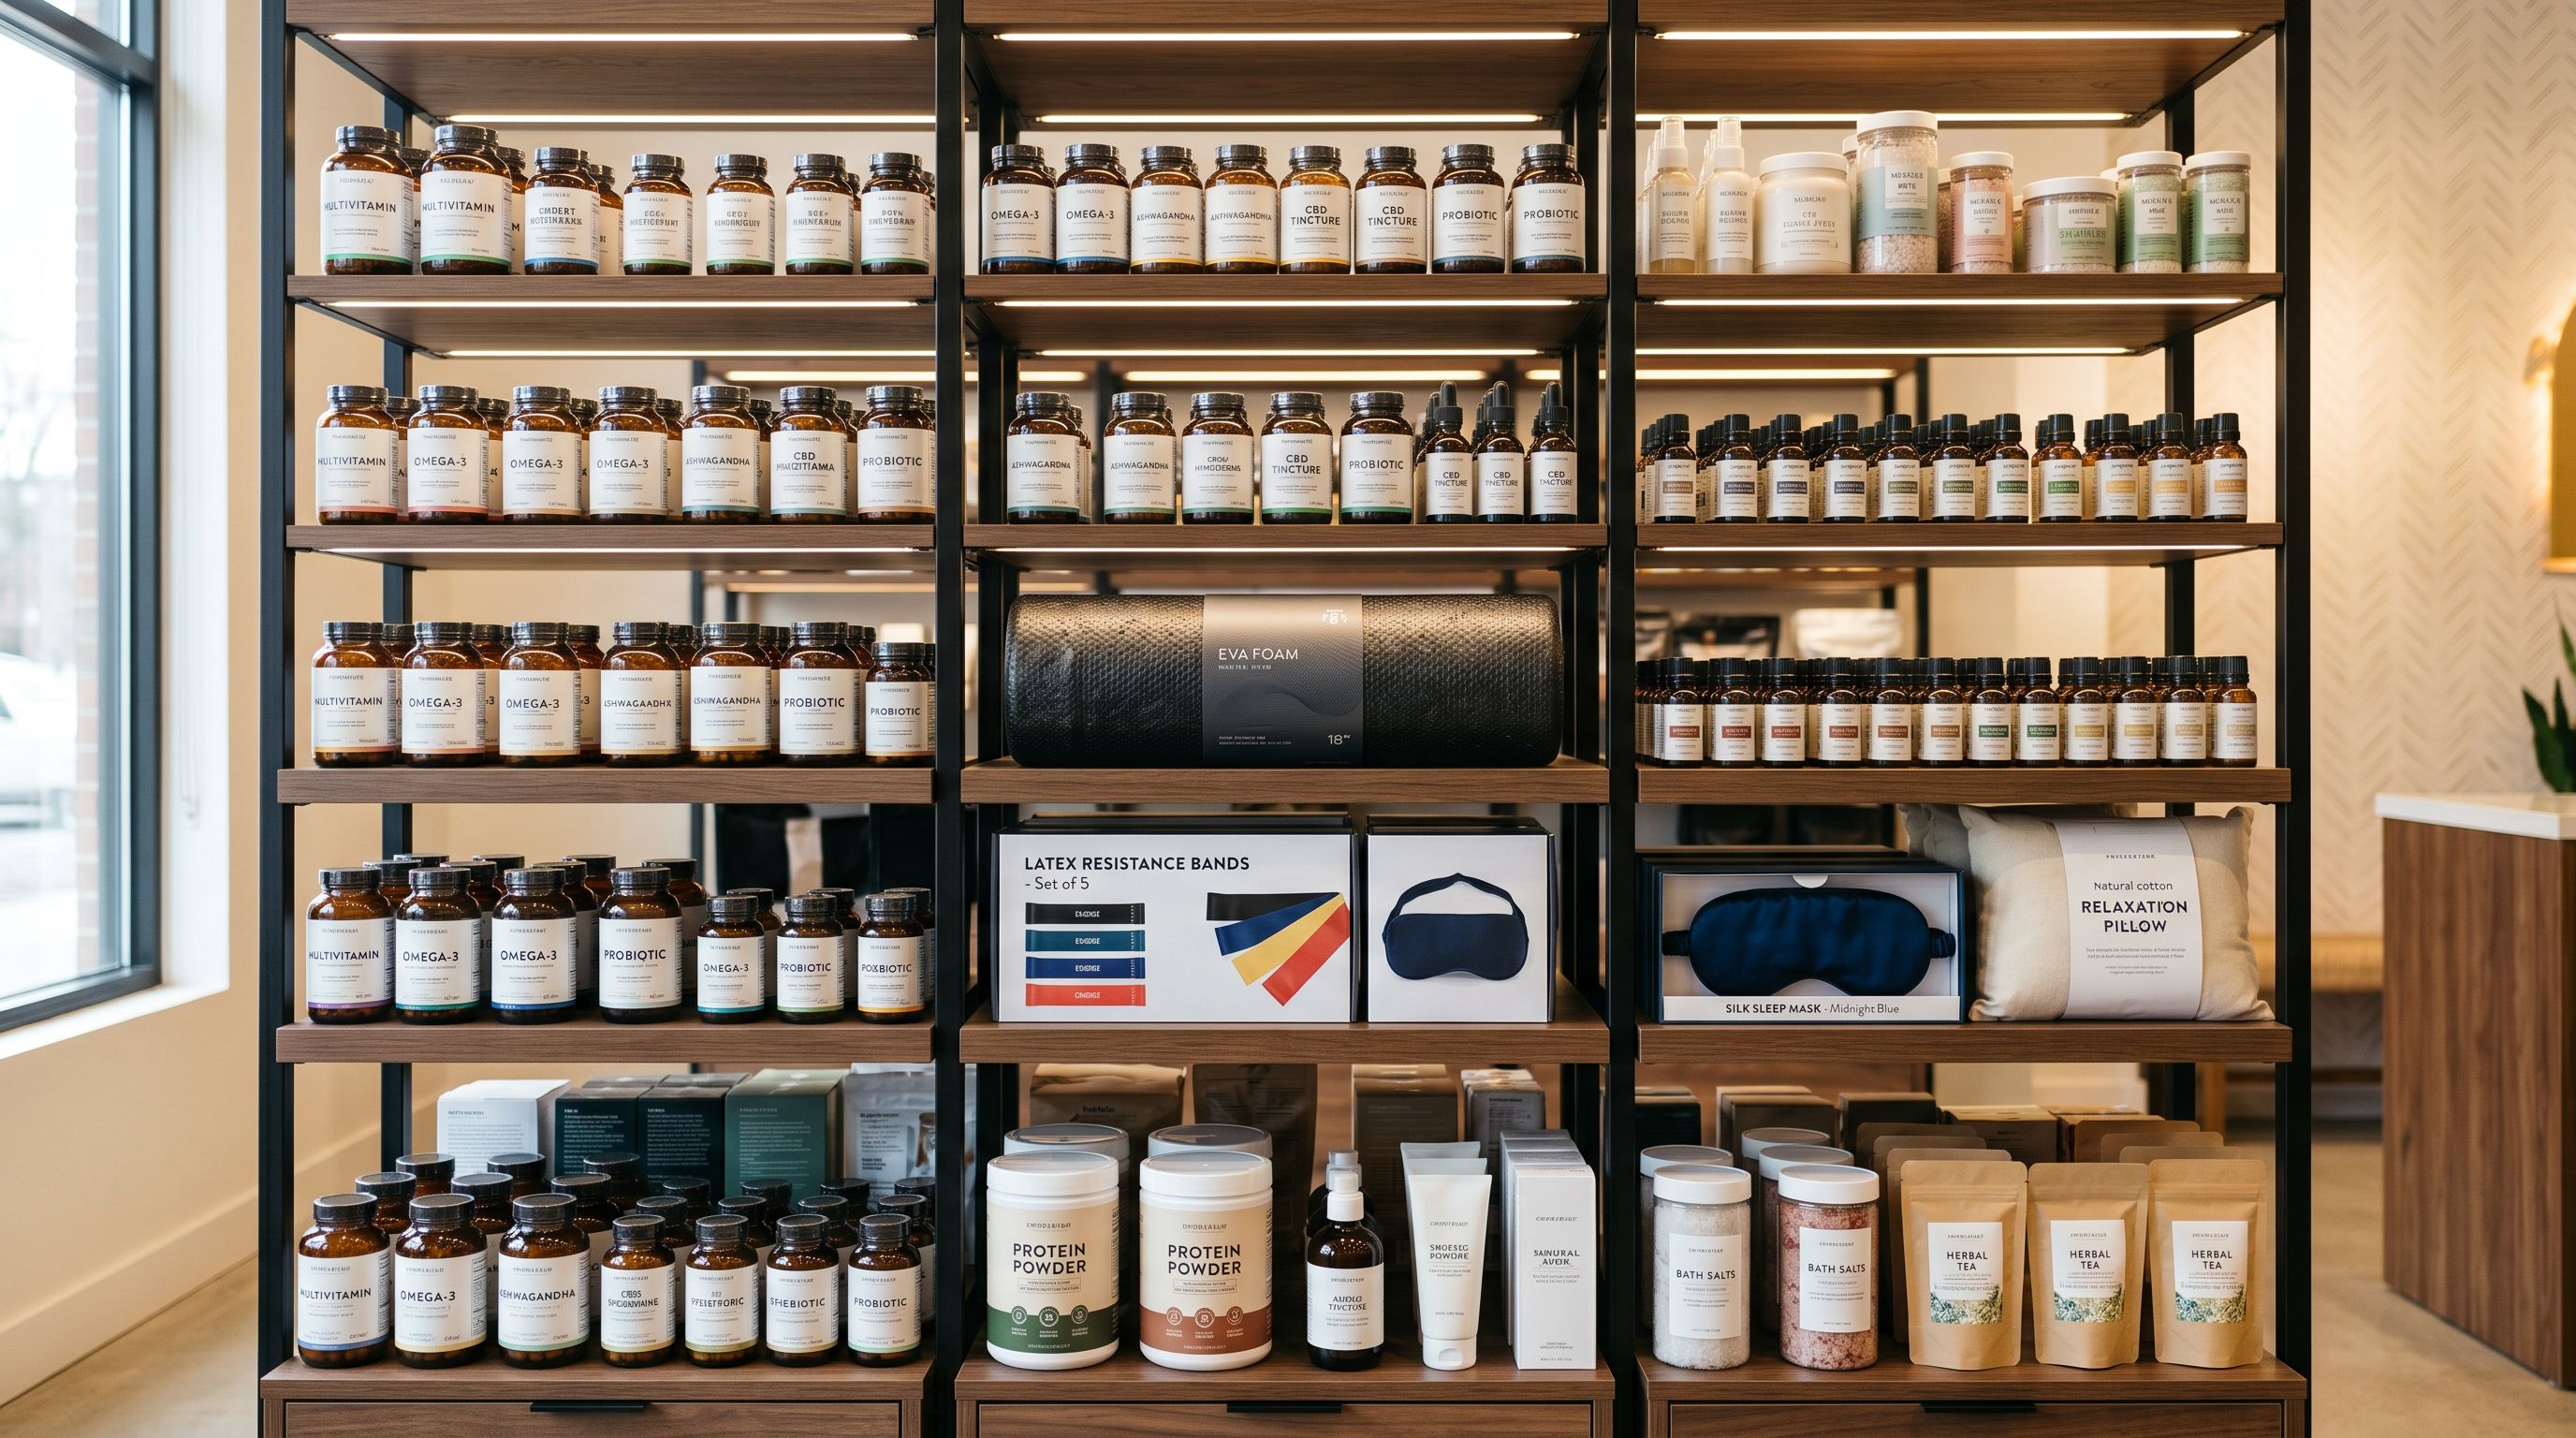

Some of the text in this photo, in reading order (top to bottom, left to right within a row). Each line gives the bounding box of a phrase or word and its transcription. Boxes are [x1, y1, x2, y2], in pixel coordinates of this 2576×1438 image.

[991, 211, 1039, 219] OMEGA-3
[1067, 210, 1114, 219] OMEGA-3
[1137, 213, 1194, 221] ASHWAGANDHA
[1443, 211, 1497, 220] PROBIOTIC
[1525, 210, 1578, 219] PROBIOTIC
[1292, 216, 1339, 225] TINCTURE
[1368, 217, 1417, 226] TINCTURE
[415, 457, 466, 466] OMEGA-3
[511, 459, 563, 468] OMEGA-3
[597, 460, 648, 468] OMEGA-3
[864, 457, 922, 466] PROBIOTIC
[1350, 461, 1403, 469] PROBIOTIC
[1273, 465, 1321, 474] TINCTURE
[1220, 649, 1297, 660] EVA FOAM
[410, 698, 461, 707] OMEGA-3
[506, 699, 559, 708] OMEGA-3
[785, 698, 844, 707] PROBIOTIC
[871, 706, 921, 717] PROBIOTIC
[1026, 858, 1249, 870] LATEX RESISTANCE BANDS
[1035, 876, 1058, 889] Set
[1062, 876, 1076, 889] of
[1081, 877, 1089, 889] 5
[2095, 881, 2133, 890] Natural
[2082, 902, 2187, 913] RELAXATION
[2104, 920, 2166, 932] PILLOW
[403, 952, 458, 961] OMEGA-3
[501, 950, 556, 961] OMEGA-3
[605, 949, 666, 961] PROBIOTIC
[781, 963, 831, 972] PROBIOTIC
[1726, 1005, 1749, 1013] SILK
[1753, 1005, 1786, 1013] SLEEP
[1790, 1005, 1821, 1013] MASK
[1830, 1004, 1877, 1017] Midnight
[1878, 1004, 1898, 1013] Blue
[1014, 1243, 1085, 1257] PROTEIN
[1169, 1244, 1240, 1258] PROTEIN
[1014, 1260, 1086, 1274] POWDER
[1169, 1261, 1240, 1275] POWDER
[1808, 1264, 1865, 1273] BATH SALTS
[1677, 1269, 1734, 1279] BATH SALTS
[402, 1291, 455, 1301] OMEGA-3
[856, 1299, 906, 1307] PROBIOTIC
